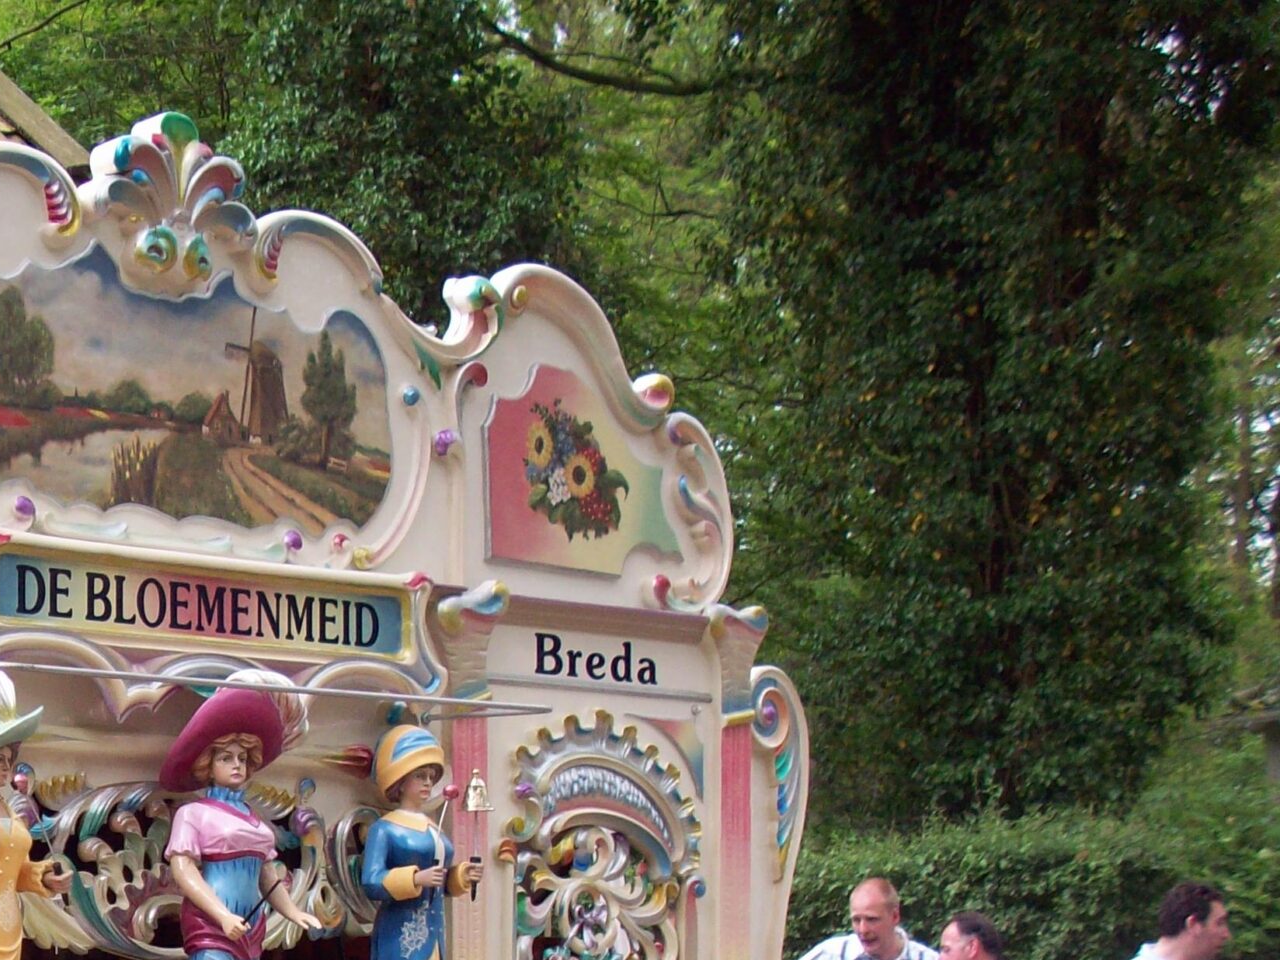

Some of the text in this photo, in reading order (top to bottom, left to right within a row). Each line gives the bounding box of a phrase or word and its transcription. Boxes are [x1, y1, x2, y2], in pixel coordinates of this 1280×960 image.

[15, 564, 380, 648] DE BLOEMENMEID
[534, 632, 658, 685] Breda
